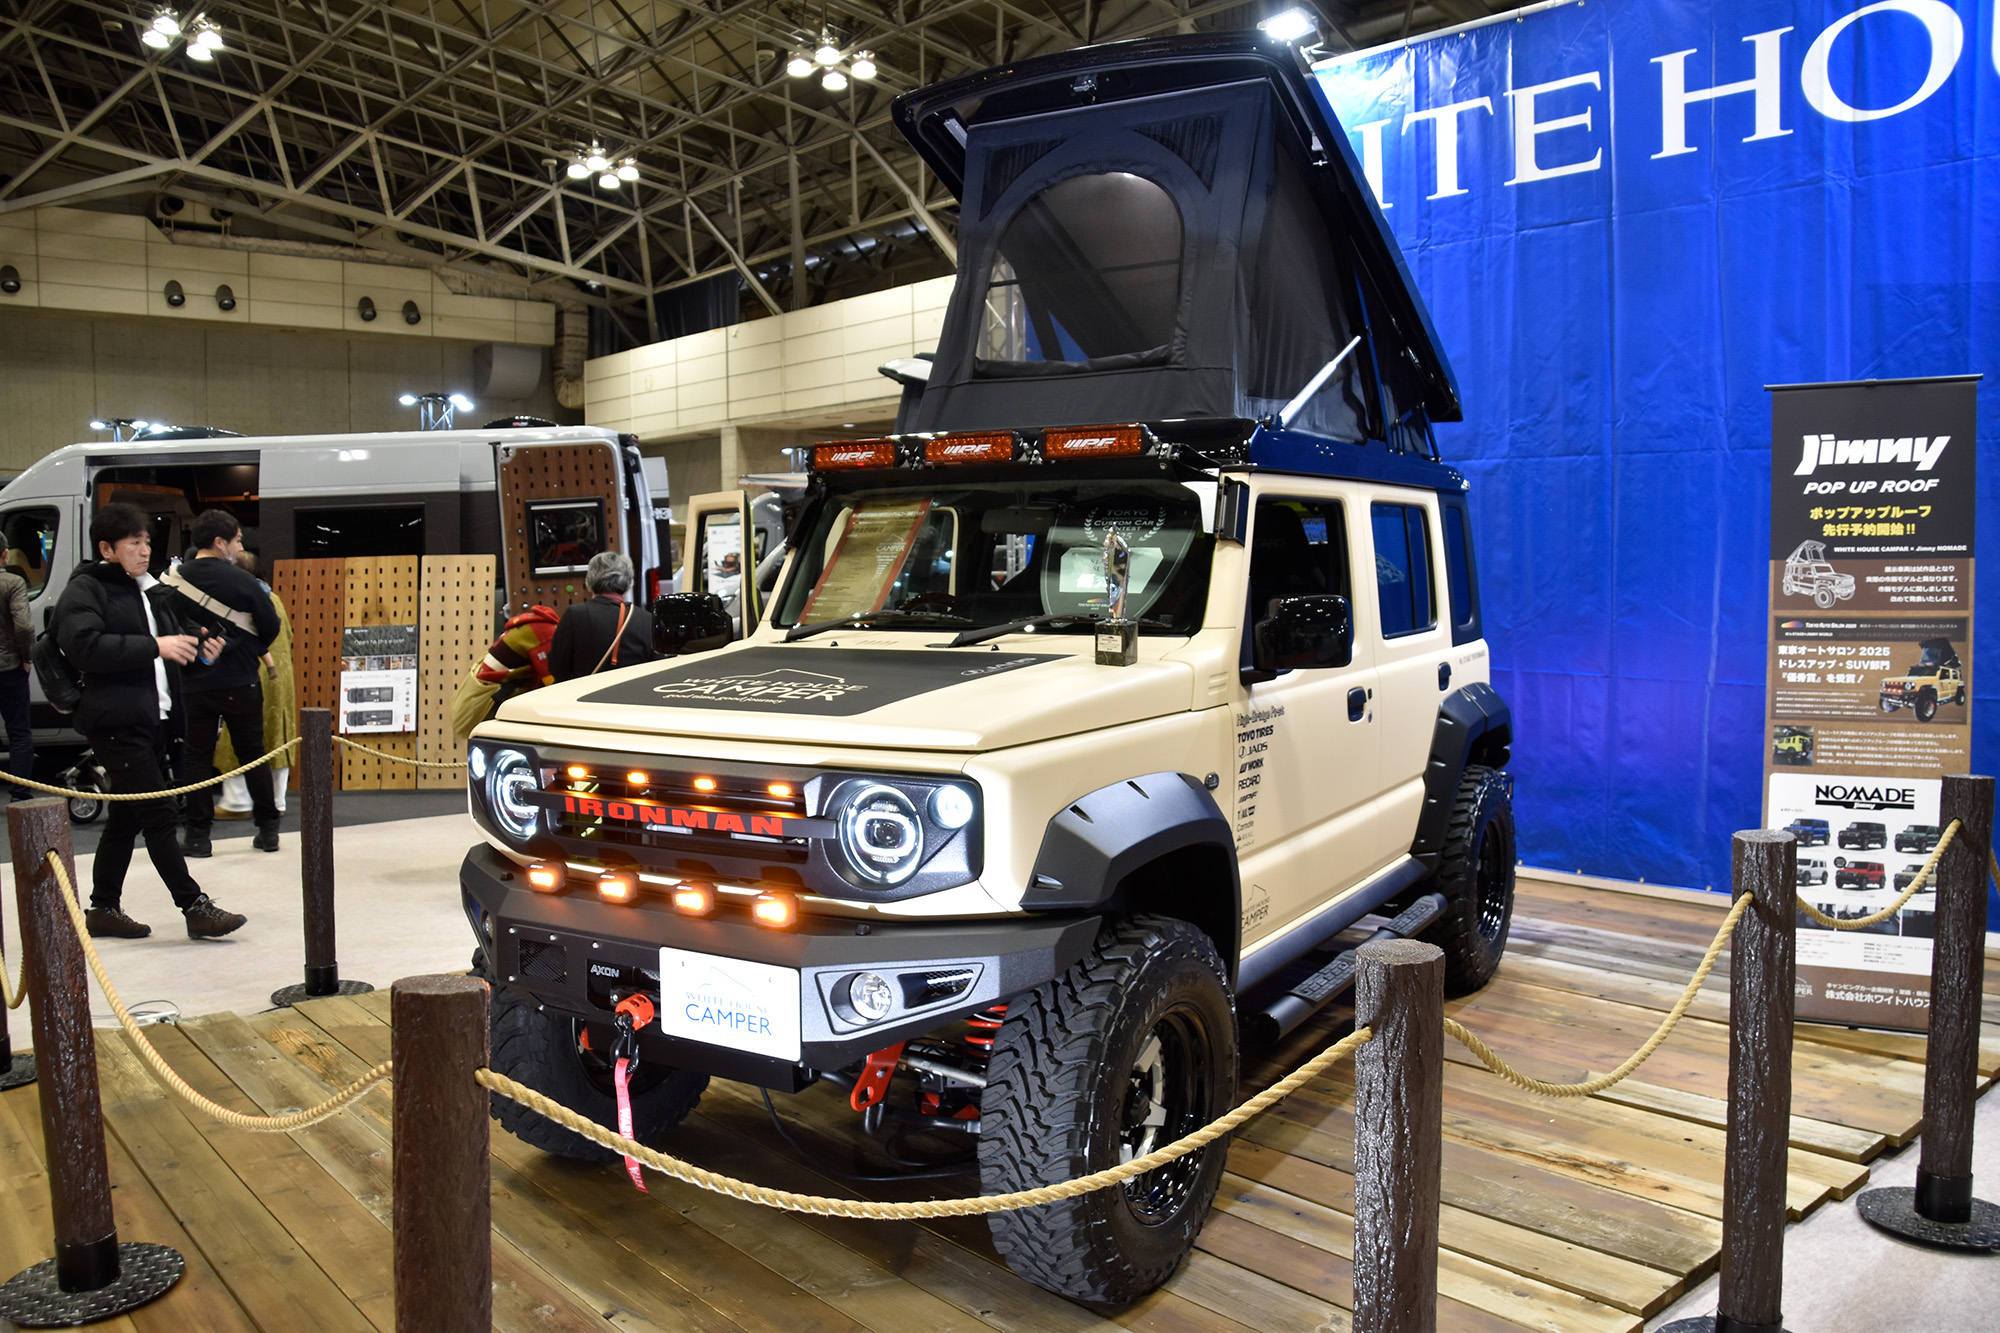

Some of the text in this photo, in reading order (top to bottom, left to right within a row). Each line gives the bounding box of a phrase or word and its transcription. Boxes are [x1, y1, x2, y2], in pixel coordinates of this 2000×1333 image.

[1650, 0, 2000, 160] HO
[1803, 478, 1940, 495] POP UP ROOF
[1809, 505, 1932, 520] ポップアップルーフ
[1778, 645, 1890, 656] 東京オートサロン 2025
[1779, 659, 1890, 670] ドレスアップ・SUV部門
[653, 683, 845, 701] CAMPER
[683, 678, 868, 691] WHITE HOUSE
[1237, 725, 1273, 743] TOYO TIRES
[1238, 774, 1261, 790] RECARO
[1815, 785, 1915, 802] NOMADE
[565, 796, 783, 836] IRONMAN
[590, 964, 619, 977] AXON
[685, 1003, 772, 1035] CAMPER
